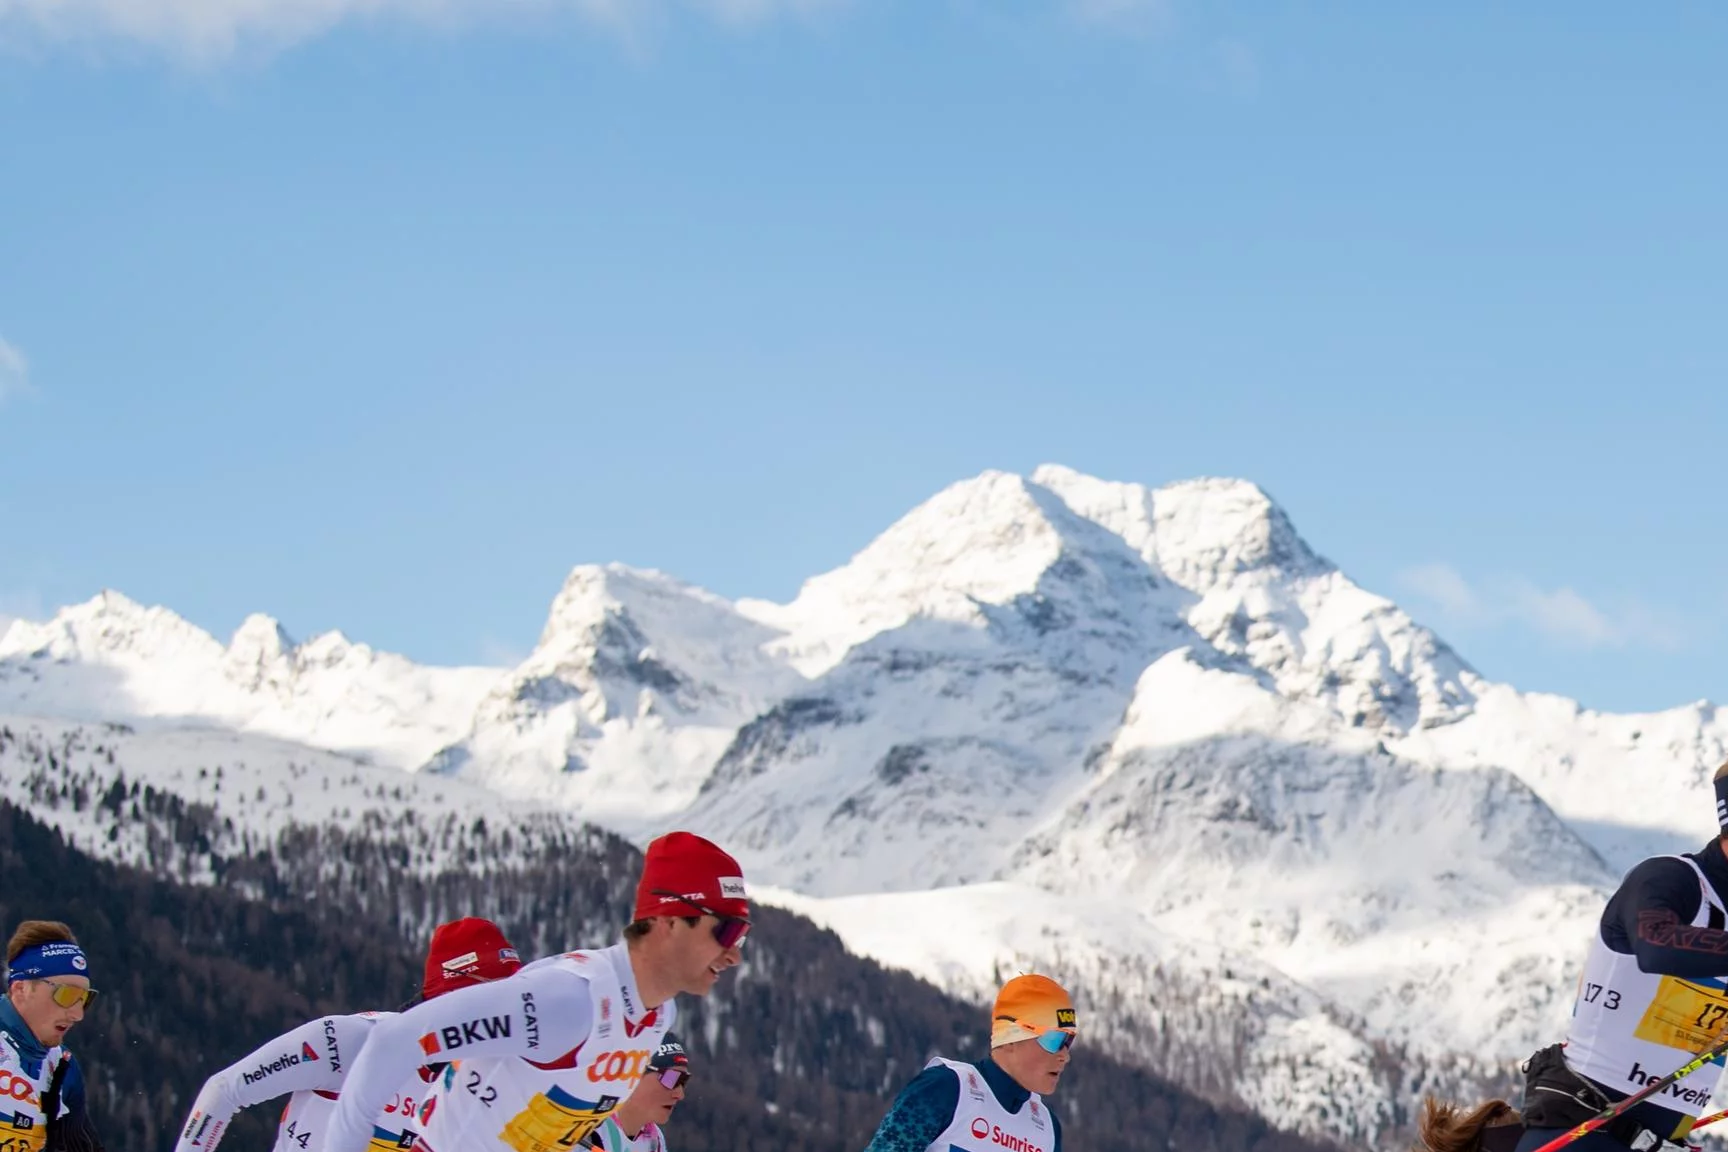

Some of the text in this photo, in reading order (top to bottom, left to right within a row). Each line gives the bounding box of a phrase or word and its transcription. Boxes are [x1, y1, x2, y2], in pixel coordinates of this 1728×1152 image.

[1583, 982, 1622, 1011] 173
[440, 1014, 512, 1051] BKW
[242, 1053, 301, 1086] helvetia
[587, 1049, 651, 1090] coop
[465, 1070, 498, 1109] 22
[286, 1120, 312, 1149] 44
